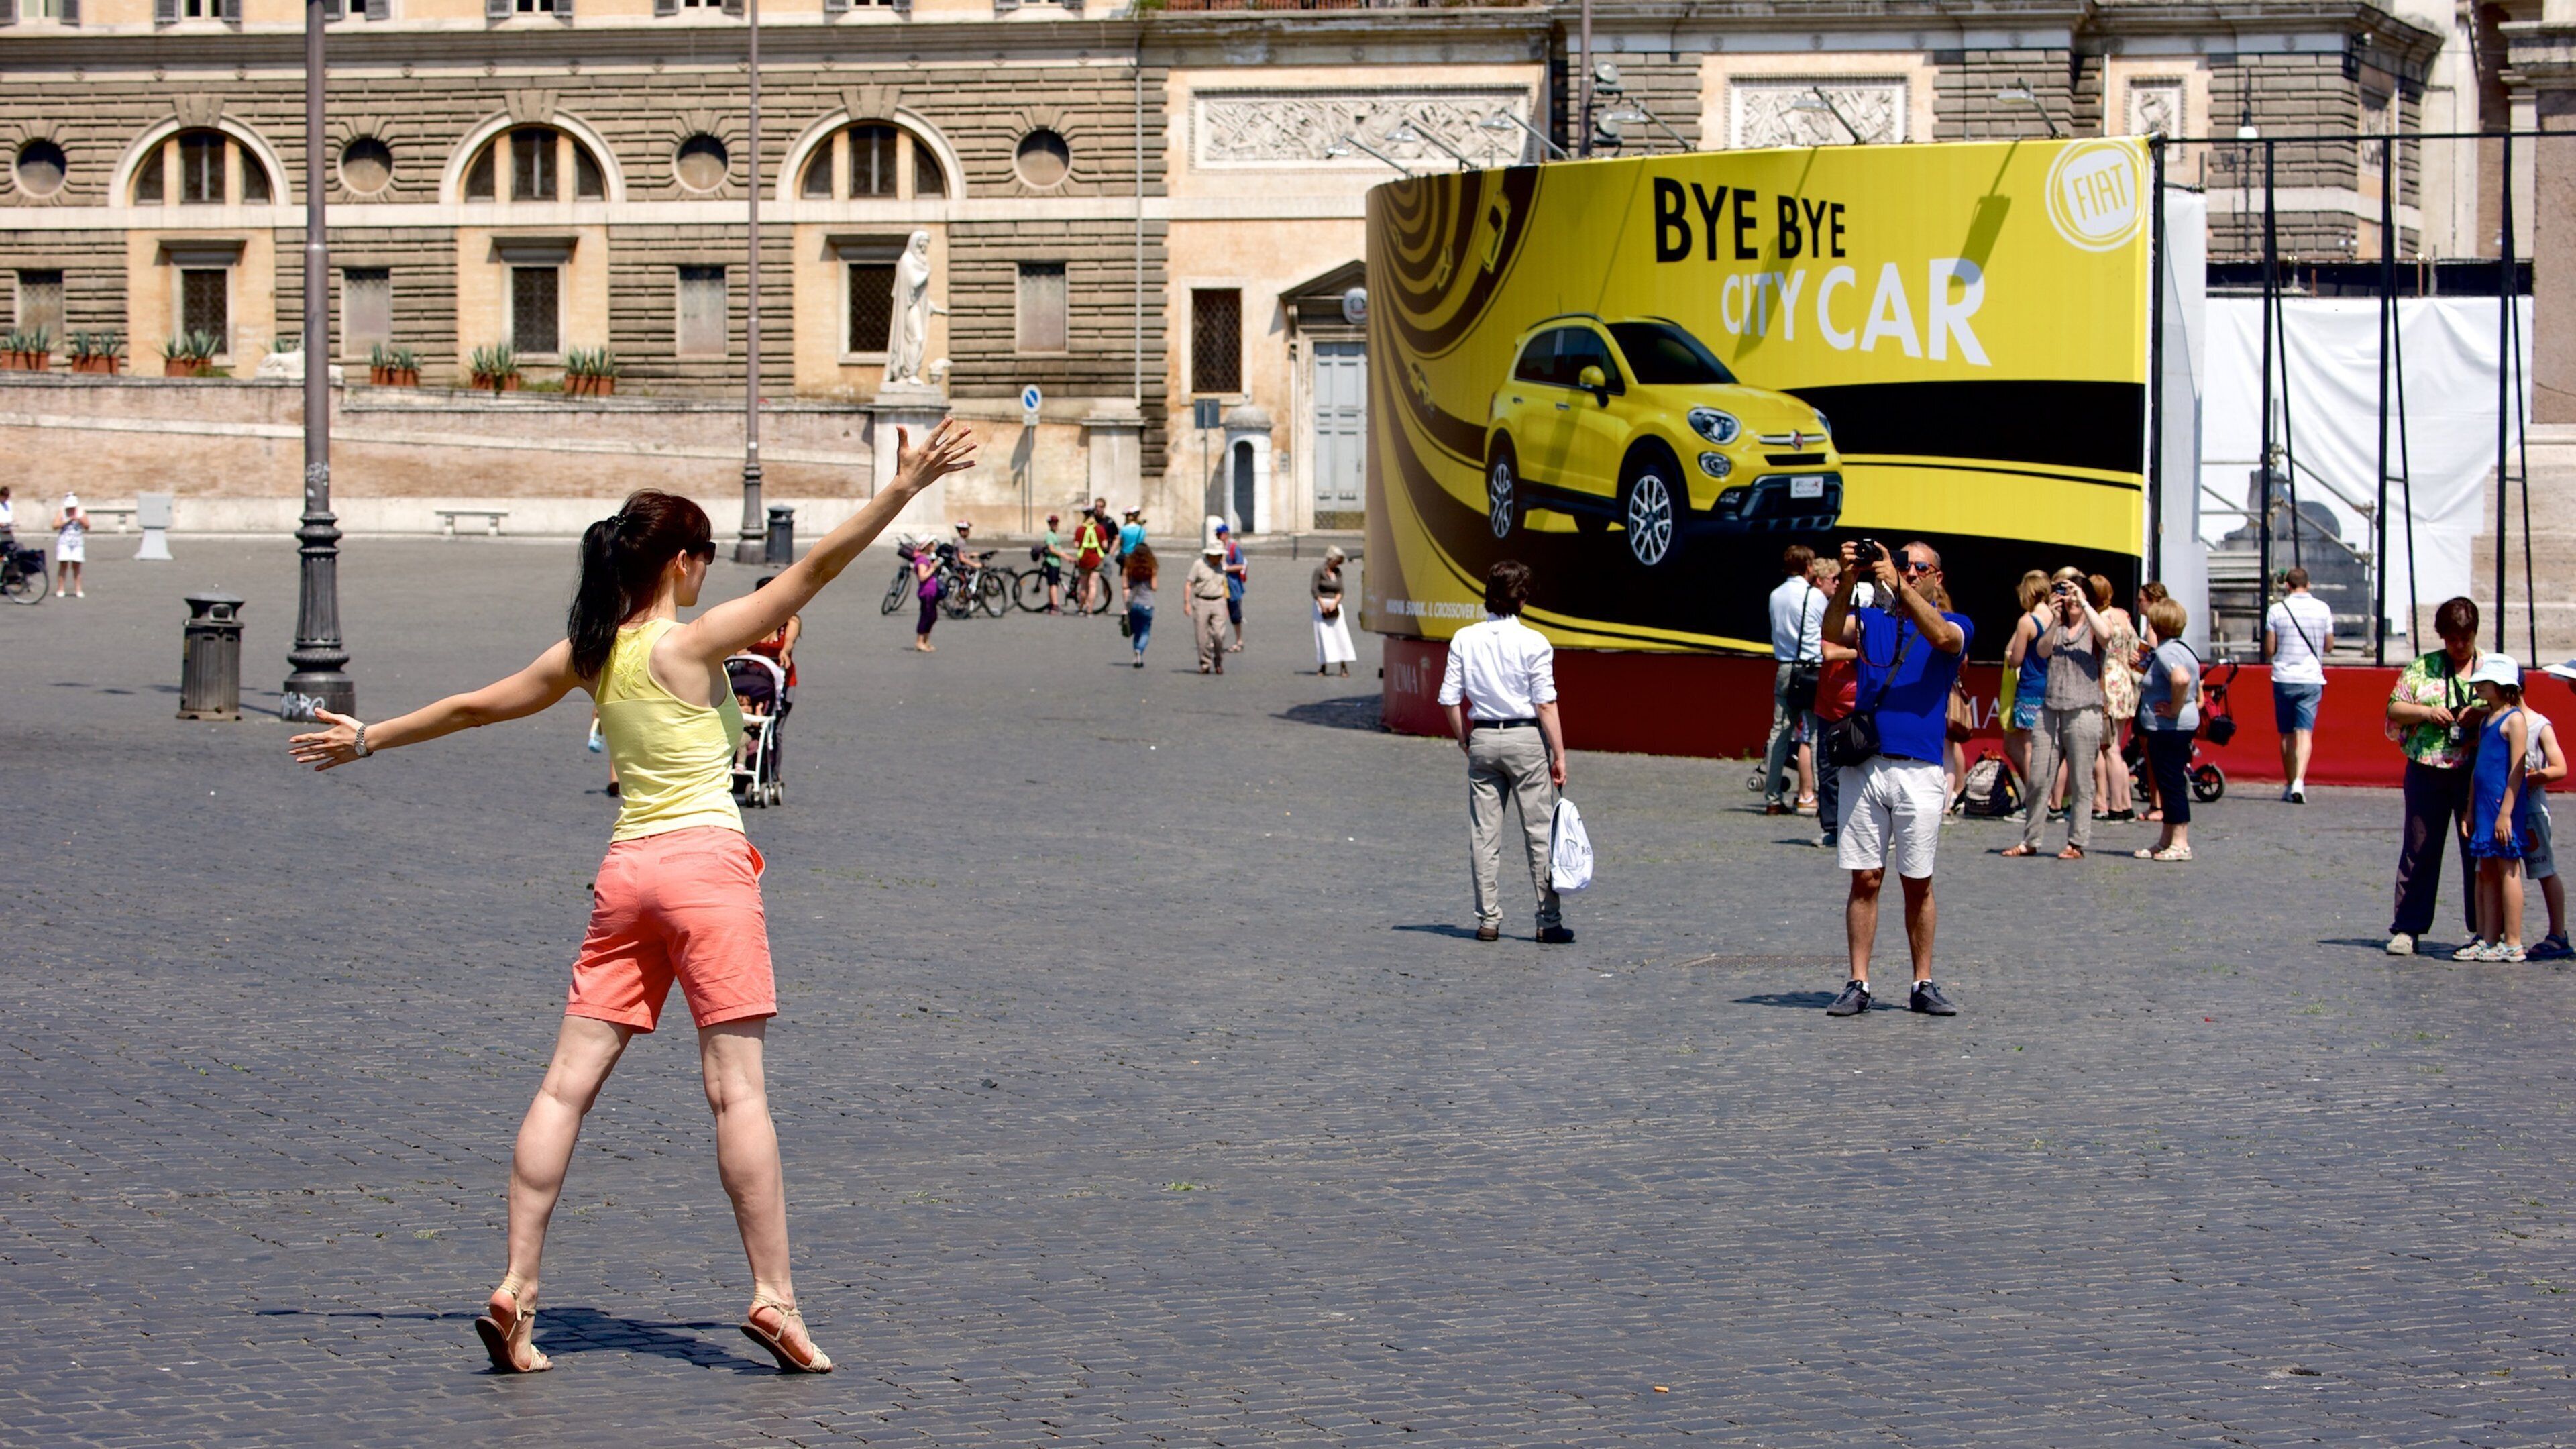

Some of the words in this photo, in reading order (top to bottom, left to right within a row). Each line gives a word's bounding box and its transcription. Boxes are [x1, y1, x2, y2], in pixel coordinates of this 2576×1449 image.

[1654, 176, 1758, 263] BYE
[1777, 195, 1846, 259] BYE
[2072, 163, 2127, 222] FIAT
[1721, 269, 1806, 341] CITY
[1817, 258, 1992, 366] CAR
